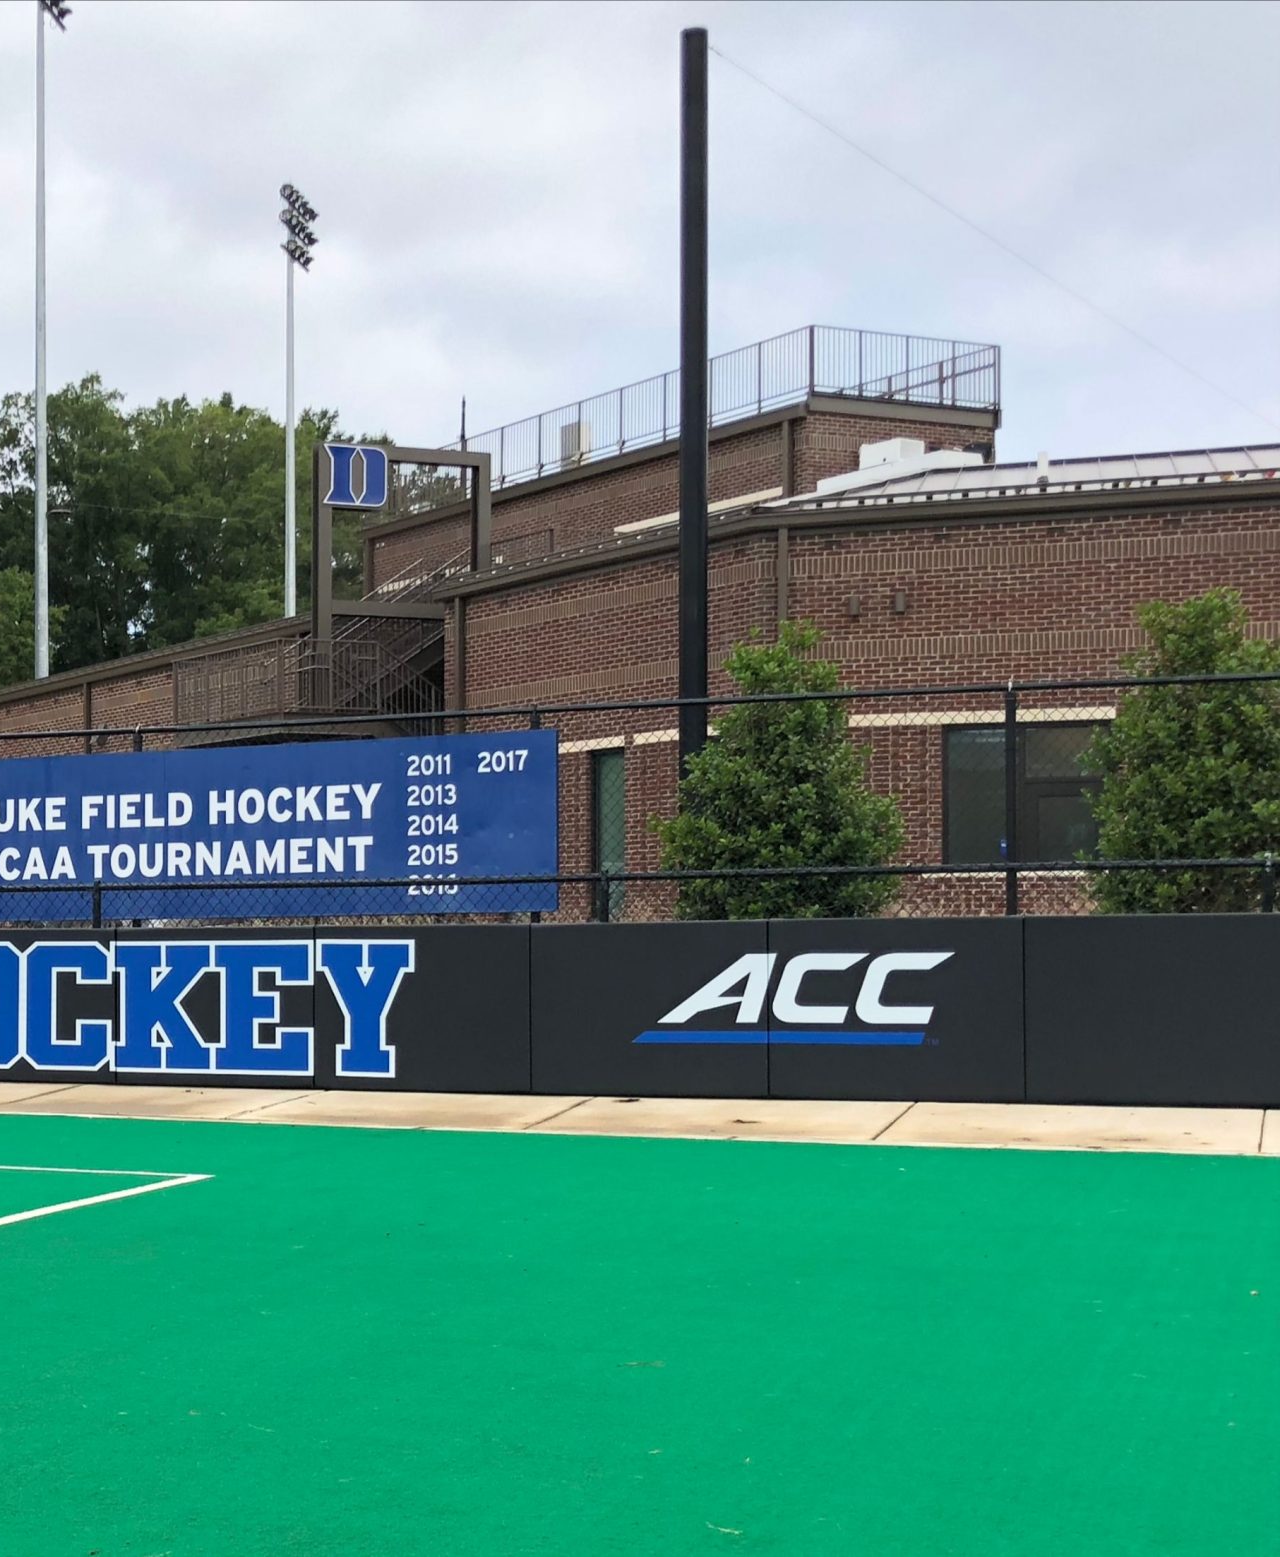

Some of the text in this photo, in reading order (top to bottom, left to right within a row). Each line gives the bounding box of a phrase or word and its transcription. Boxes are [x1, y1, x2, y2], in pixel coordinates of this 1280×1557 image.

[407, 753, 451, 777] 2011
[477, 749, 529, 773] 2017
[81, 792, 193, 830] FIELD
[209, 782, 382, 825] HOCKEY
[407, 783, 457, 806] 2013
[407, 813, 459, 836] 2014
[86, 835, 374, 879] TOURNAMENT
[407, 843, 459, 866] 2015
[407, 873, 459, 896] 2016
[657, 951, 955, 1025] ACC
